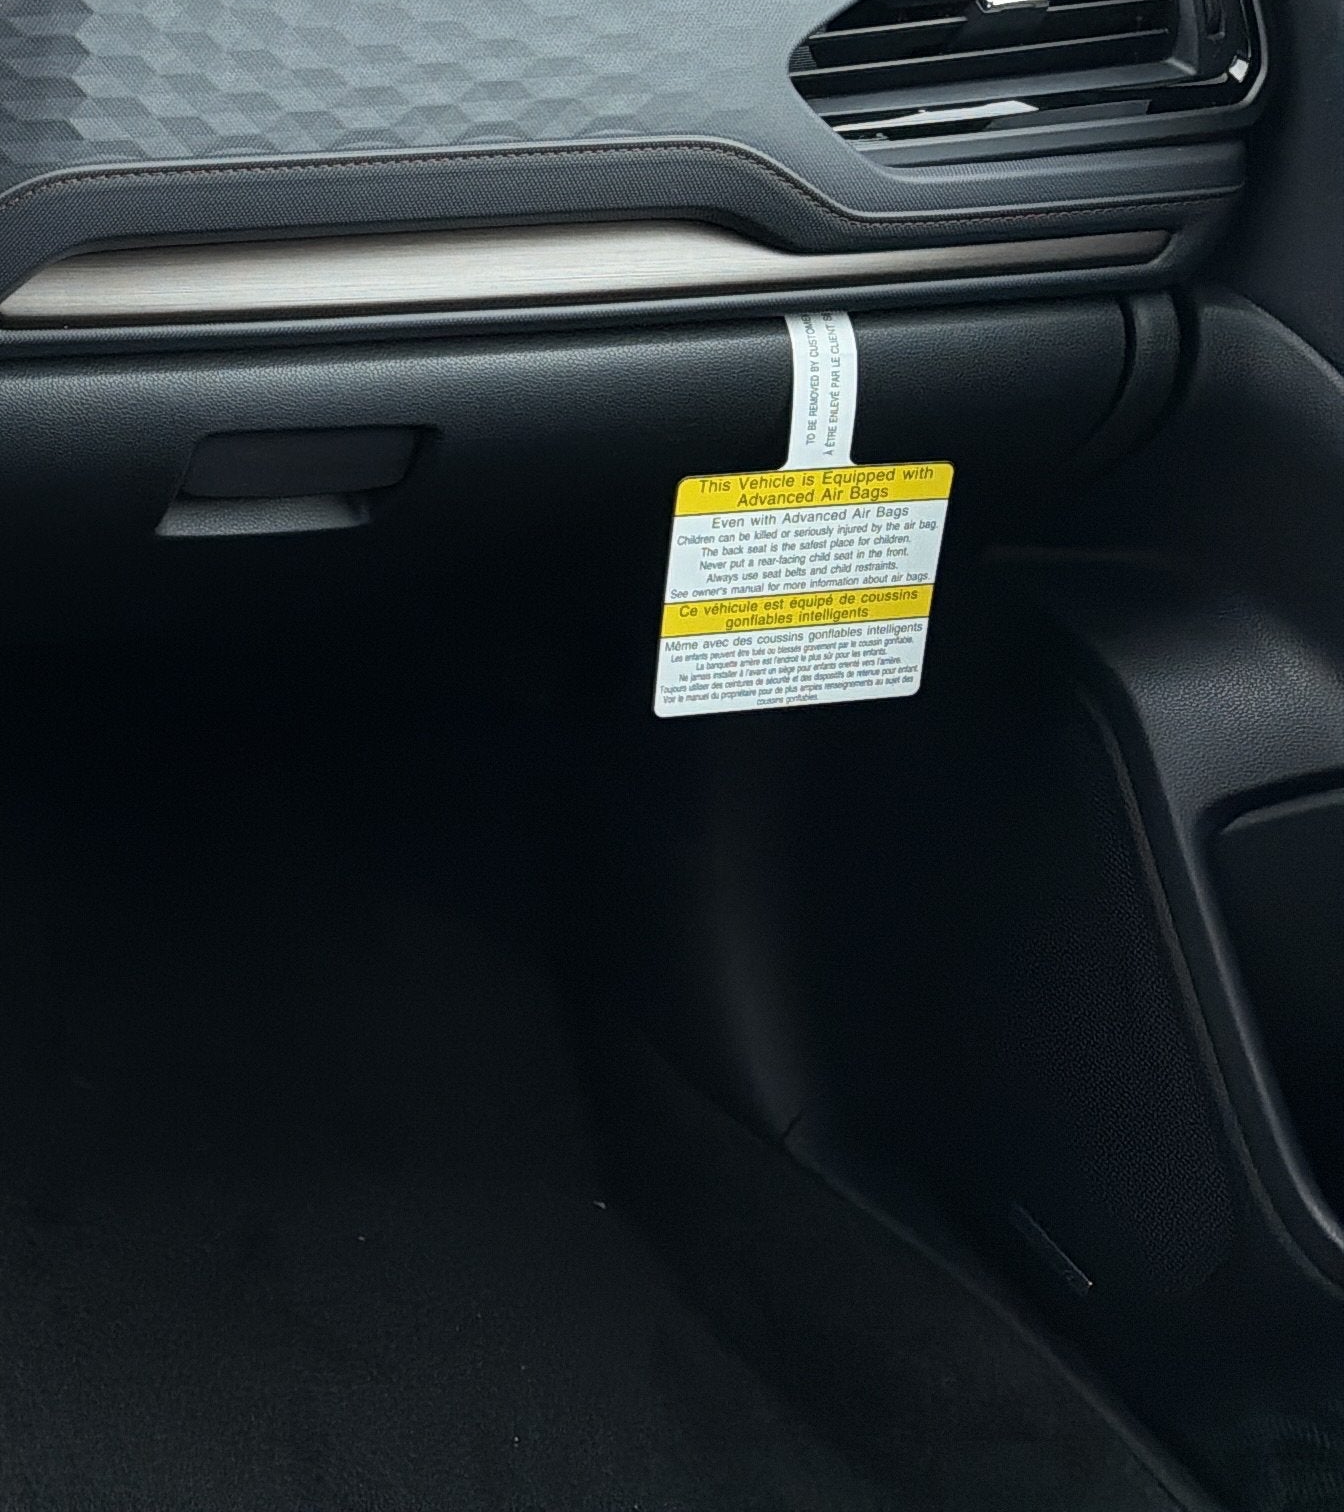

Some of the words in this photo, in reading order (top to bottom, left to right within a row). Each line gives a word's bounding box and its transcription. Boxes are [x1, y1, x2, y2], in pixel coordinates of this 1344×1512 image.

[801, 313, 819, 358] CUSTOME
[825, 324, 840, 355] CLIENT
[810, 361, 820, 372] BY
[830, 357, 841, 368] LE
[830, 370, 841, 388] PAR
[808, 375, 820, 417] REMOVED
[807, 419, 817, 431] BE
[806, 433, 816, 445] TO
[824, 426, 837, 447] ÊTRE
[699, 479, 731, 493] This
[739, 475, 794, 490] Vehicle
[802, 473, 814, 486] is
[822, 468, 895, 486] Equipped
[903, 466, 933, 480] with
[737, 489, 815, 507] Advanced
[821, 487, 843, 501] Air
[850, 486, 888, 501] Bags
[711, 517, 744, 529] Even
[750, 514, 776, 526] with
[781, 509, 847, 524] Advanced
[851, 507, 871, 519] Air
[876, 506, 909, 519] Bags
[677, 534, 715, 546] Children
[718, 534, 735, 542] can
[738, 531, 750, 541] be
[753, 528, 778, 540] killed
[780, 530, 791, 538] or
[793, 525, 834, 537] seriously
[837, 522, 868, 536] injured
[870, 522, 882, 534] by
[885, 521, 900, 531] the
[903, 519, 916, 530] air
[701, 547, 718, 557] The
[721, 545, 743, 555] back
[747, 544, 767, 554] seat
[770, 542, 778, 552] is
[781, 542, 796, 551] the
[799, 539, 827, 550] safest
[829, 538, 854, 549] place
[857, 536, 870, 546] for
[699, 560, 727, 570] Never
[729, 558, 745, 570] put
[747, 559, 754, 567] a
[757, 554, 806, 566] rear-facing
[809, 551, 831, 562] child
[833, 550, 853, 561] seat
[856, 549, 865, 559] in
[867, 548, 883, 560] the
[706, 573, 738, 583] Always
[741, 572, 758, 580] use
[762, 568, 781, 579] seat
[784, 567, 806, 577] belts
[809, 565, 827, 575] and
[830, 563, 852, 574] child
[670, 589, 688, 599] See
[731, 582, 764, 594] manual
[767, 582, 780, 591] for
[783, 581, 806, 590] more
[809, 576, 859, 588] information
[862, 574, 888, 584] about
[891, 572, 903, 582] air
[679, 605, 698, 617] Ce
[704, 601, 758, 615] véhicule
[763, 599, 784, 610] est
[789, 594, 833, 610] équipé
[839, 593, 855, 605] de
[861, 589, 918, 603] coussins
[725, 612, 792, 630] gonflables
[799, 607, 868, 622] intelligents
[664, 641, 698, 651] Même
[702, 638, 729, 649] avec
[732, 636, 752, 646] des
[756, 631, 803, 644] coussins
[808, 627, 862, 643] gonflables
[866, 622, 923, 636] intelligents
